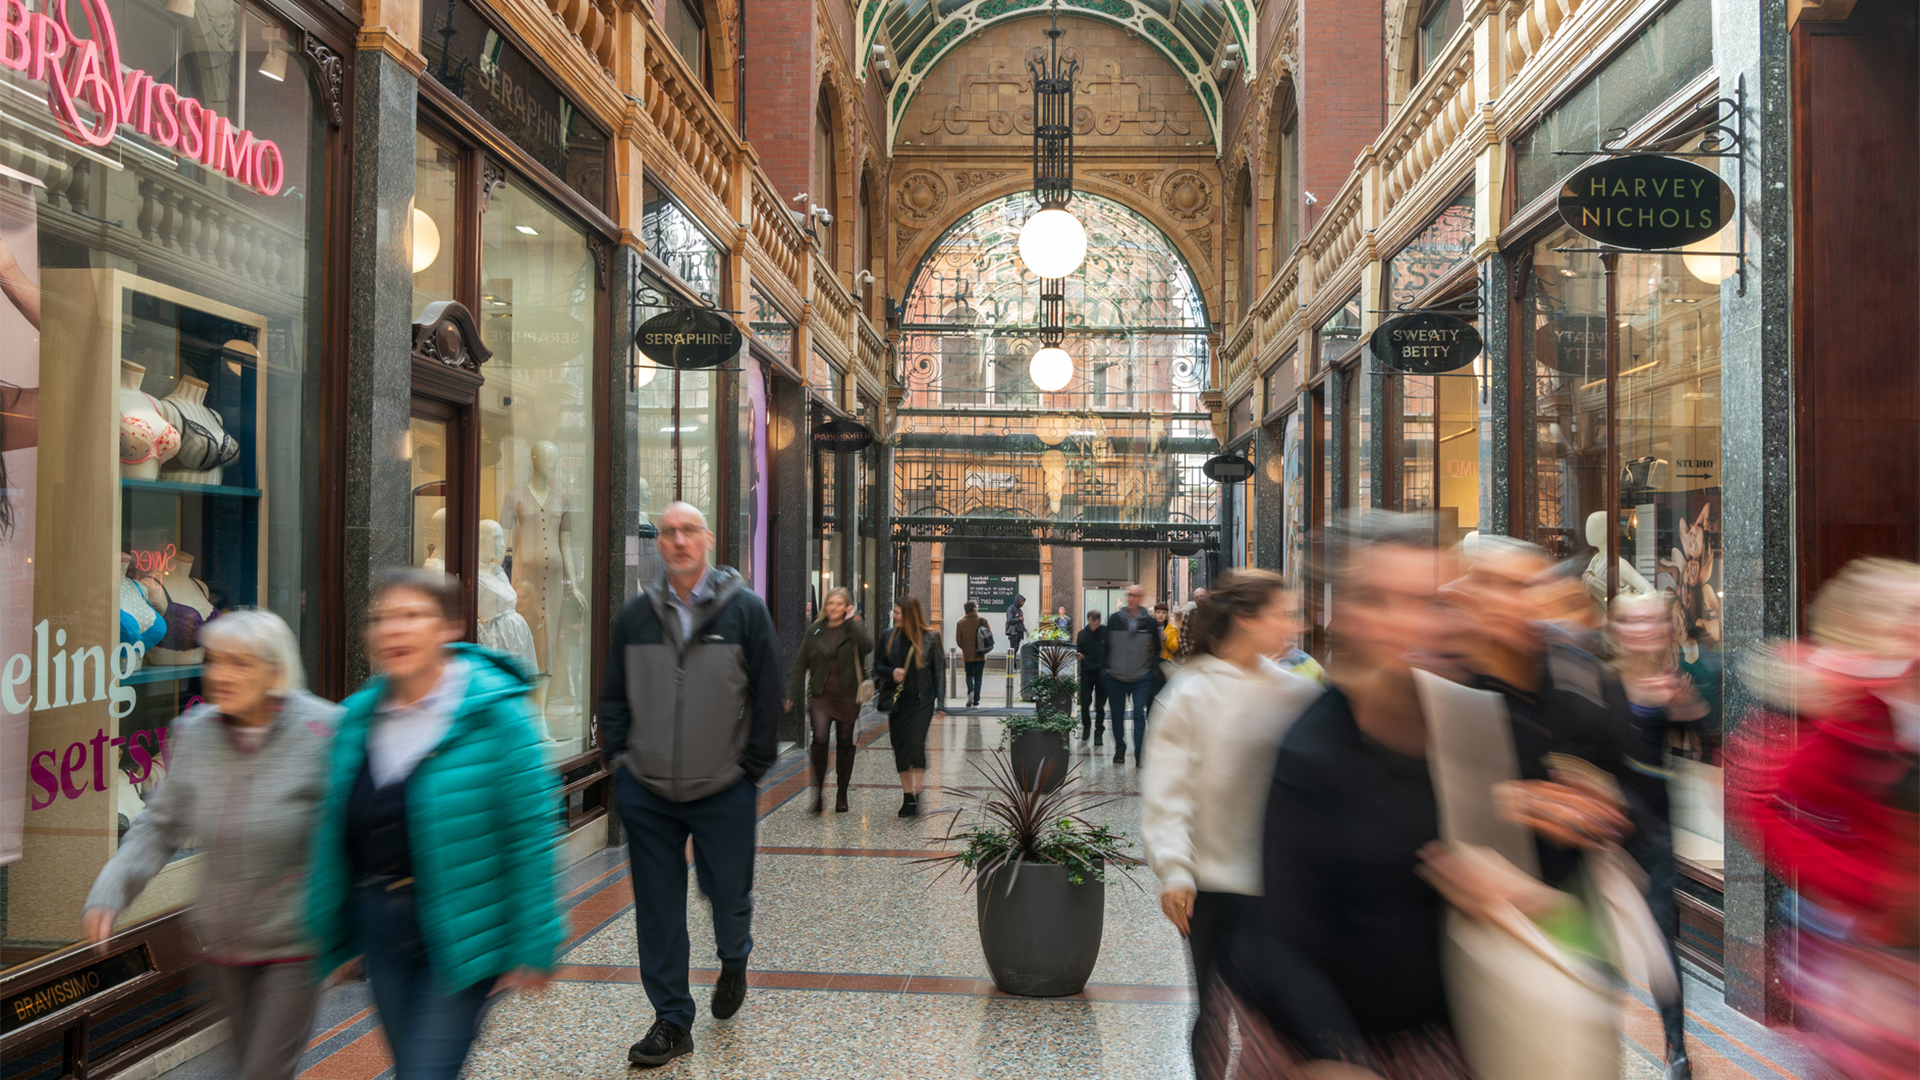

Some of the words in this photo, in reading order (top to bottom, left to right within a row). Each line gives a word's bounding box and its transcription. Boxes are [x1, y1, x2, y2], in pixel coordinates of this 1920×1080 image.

[0, 0, 284, 196] BRAVISSIMO
[479, 68, 567, 154] SERAPHIN
[1591, 177, 1705, 198] HARVEY
[1582, 206, 1712, 229] NICHOLS
[645, 333, 732, 346] SERAPHINE
[1393, 329, 1459, 341] SWEATY
[1401, 345, 1450, 357] BETTY
[1676, 459, 1713, 468] STUDIO
[13, 970, 100, 1021] BRAVISSIMO
